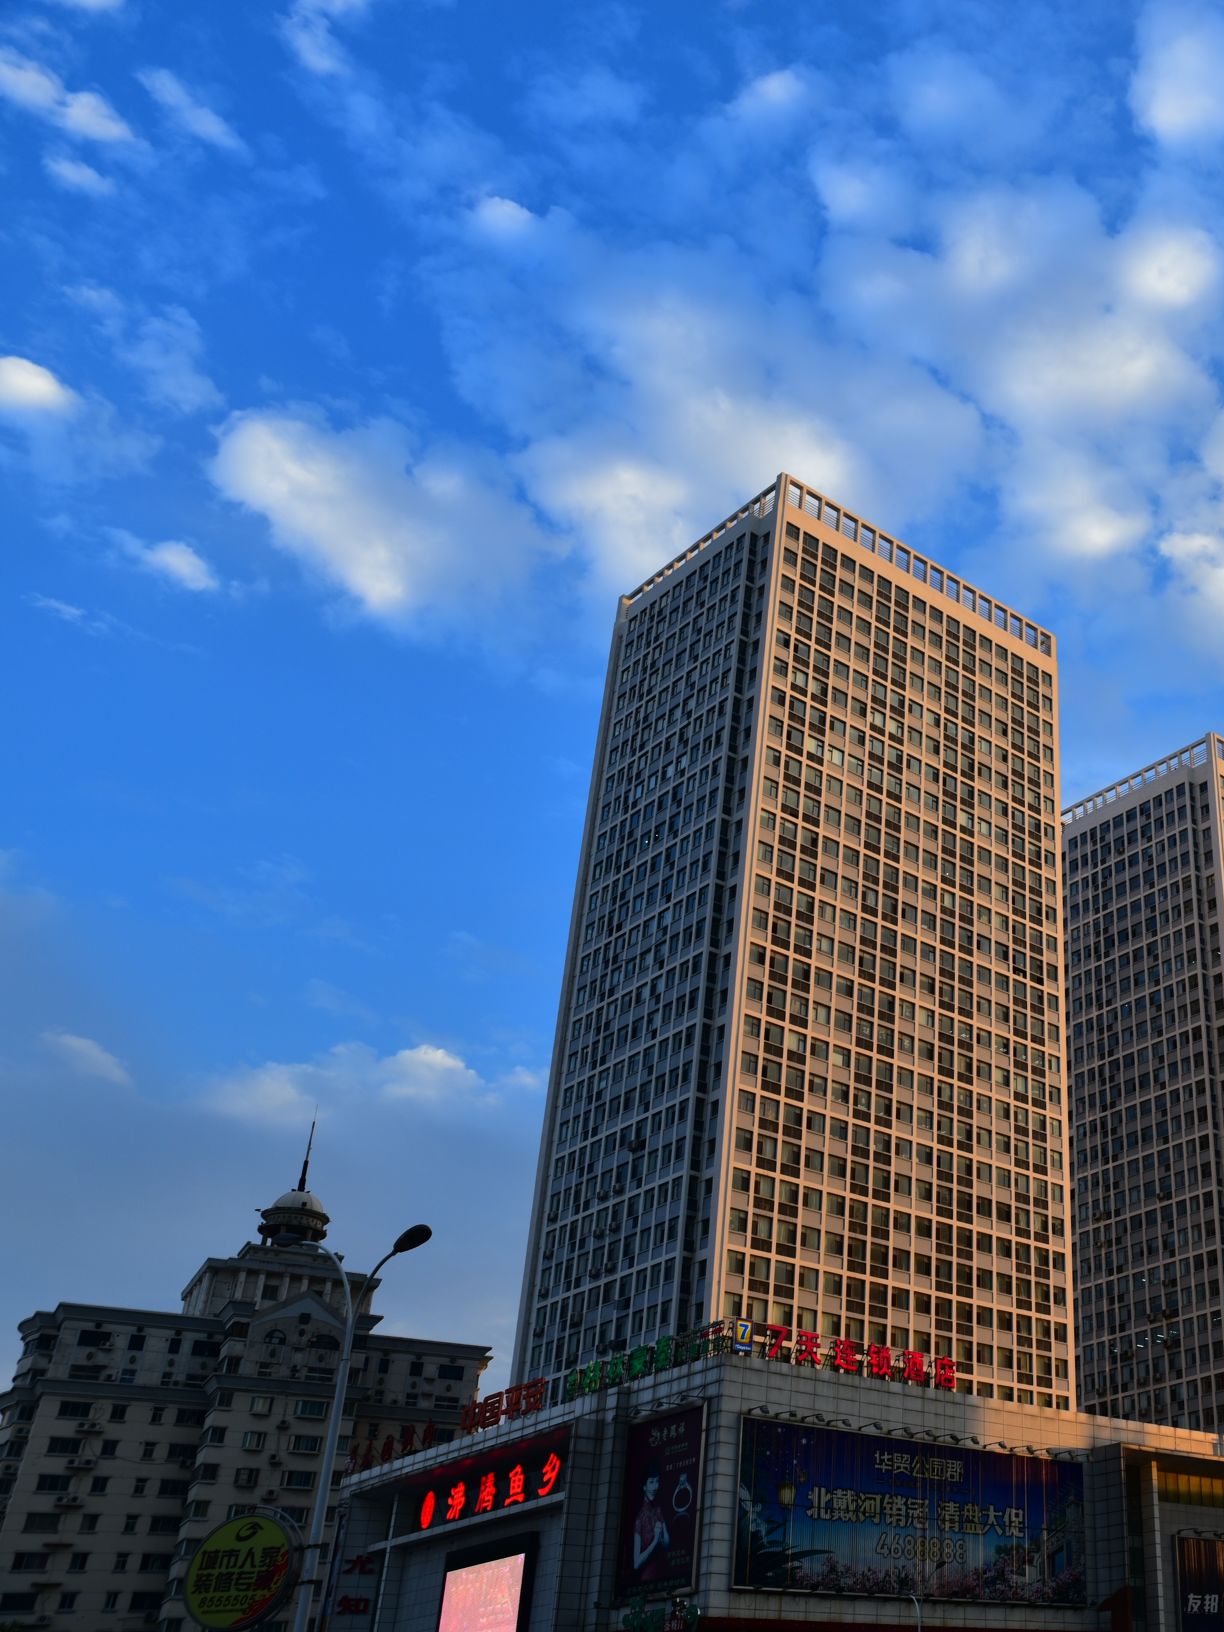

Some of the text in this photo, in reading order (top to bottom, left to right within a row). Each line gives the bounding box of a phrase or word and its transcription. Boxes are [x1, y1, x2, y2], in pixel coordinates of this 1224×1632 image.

[766, 1325, 956, 1389] 7天连锁酒店
[461, 1377, 549, 1431] 中国平安
[445, 1450, 562, 1521] 沸腾鱼乡
[874, 1450, 964, 1482] 华贸公园郡
[806, 1486, 1025, 1538] 北戴河销冠 清盘大促
[198, 1544, 285, 1570] 城市人家
[876, 1532, 968, 1564] 4688888
